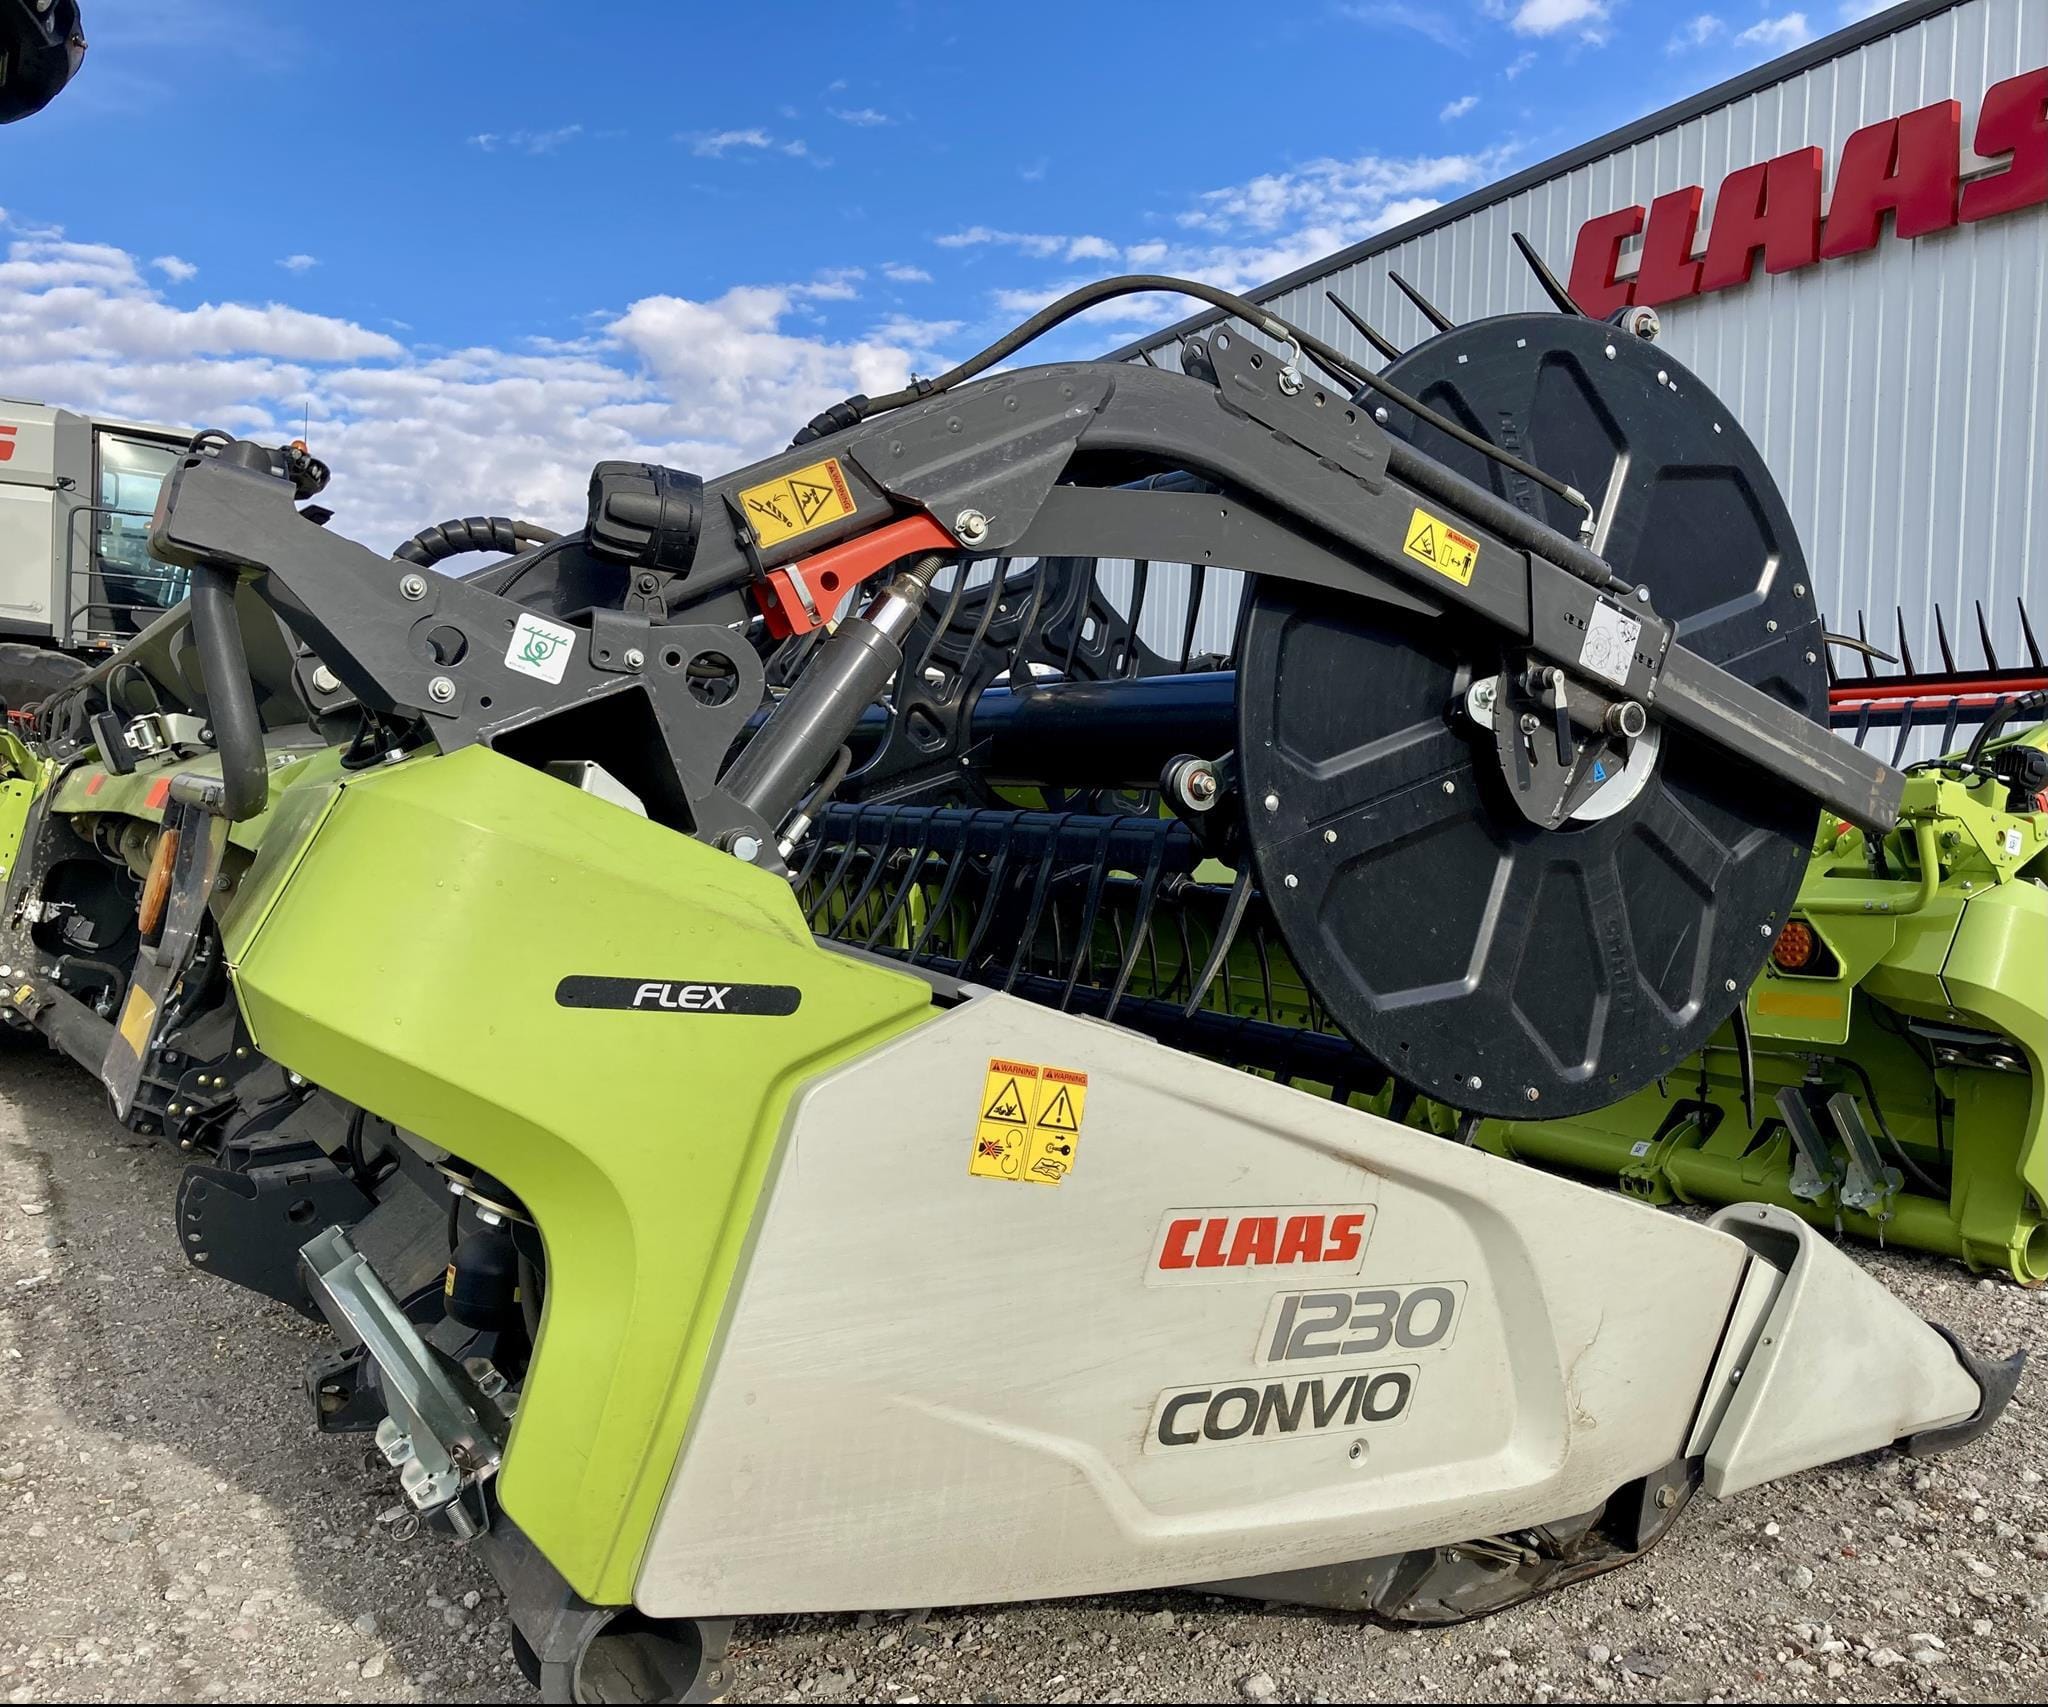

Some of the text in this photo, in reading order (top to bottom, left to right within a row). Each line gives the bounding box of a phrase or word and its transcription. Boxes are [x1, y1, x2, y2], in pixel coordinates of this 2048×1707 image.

[1568, 66, 2048, 319] CLAAS
[831, 472, 851, 509] WARNING
[632, 983, 731, 1010] FLEX
[1001, 1063, 1037, 1077] WARNING
[1053, 1072, 1086, 1084] WARNING
[1158, 1213, 1367, 1270] CLAAS
[1267, 1286, 1456, 1362] 1230
[1157, 1371, 1412, 1447] CONVIO
